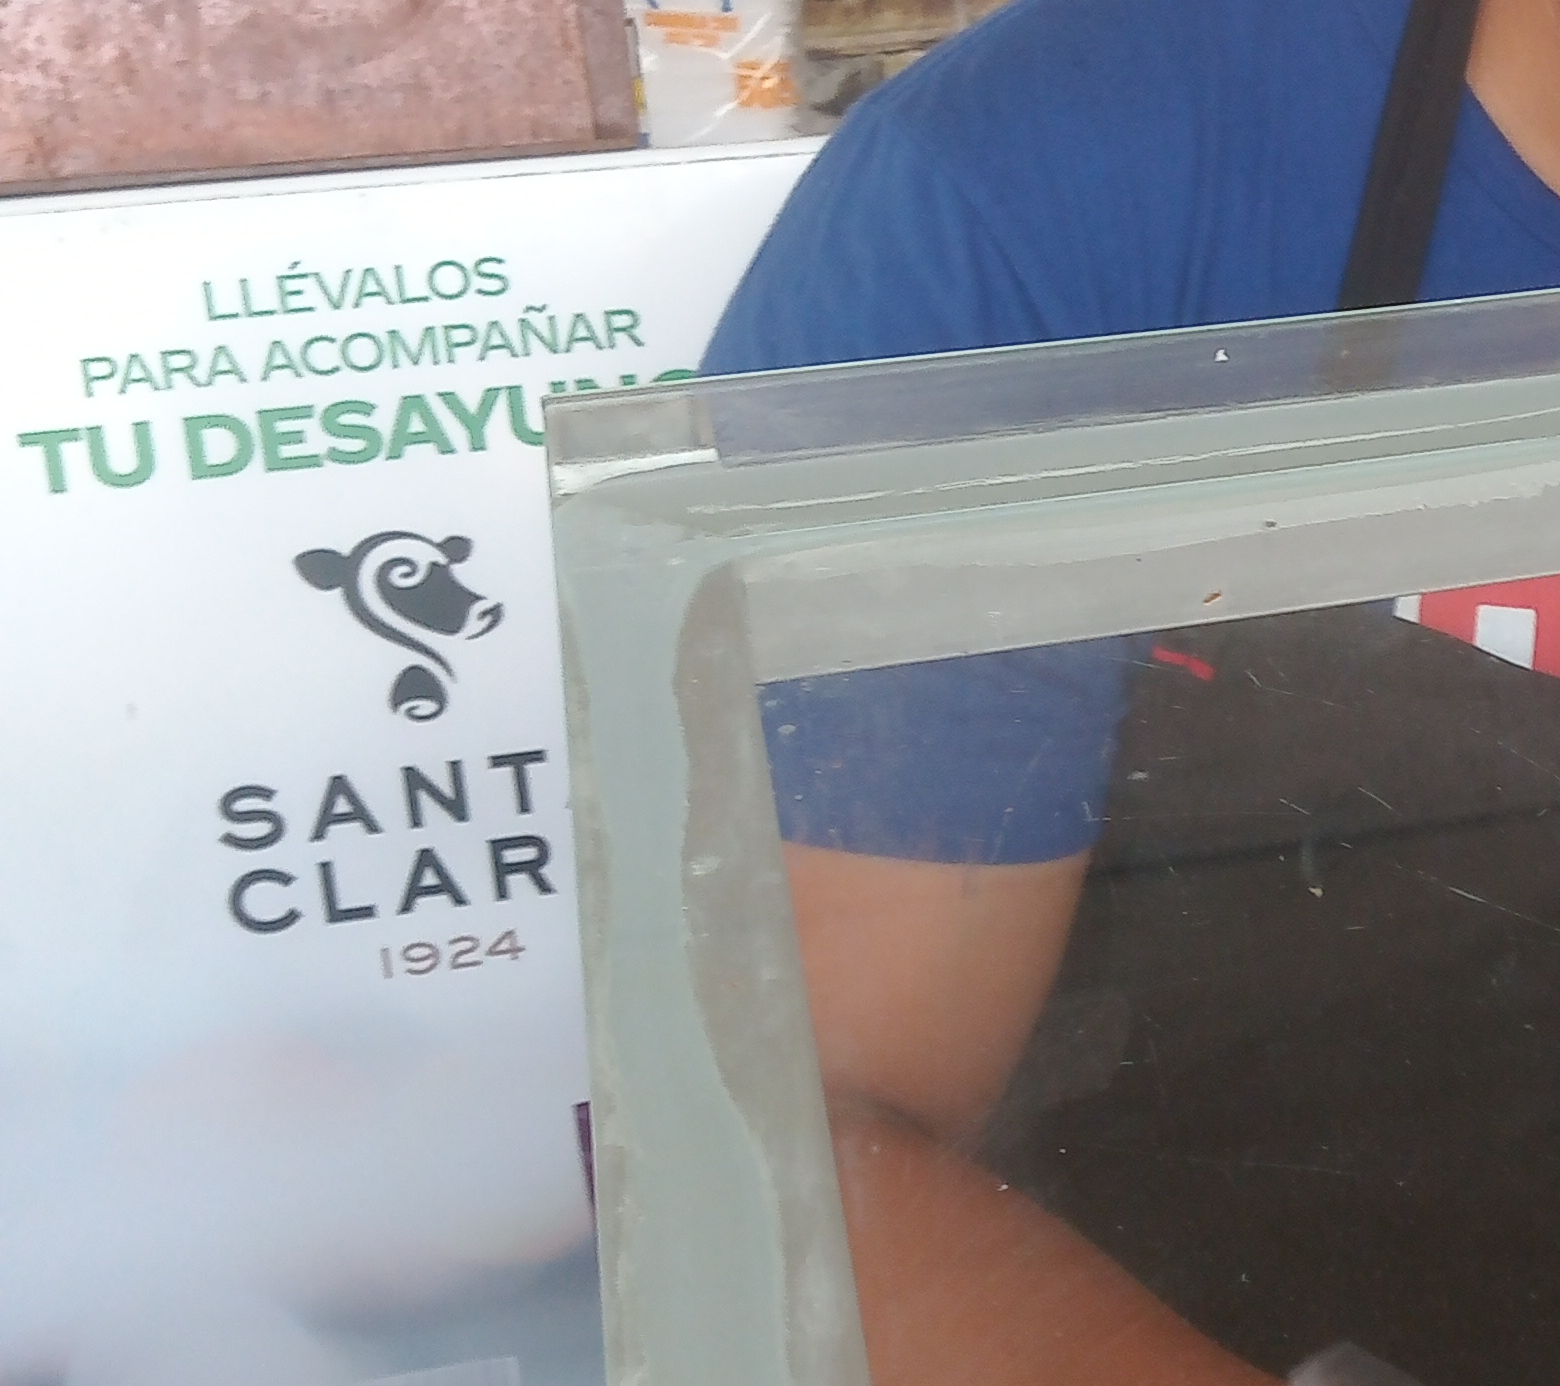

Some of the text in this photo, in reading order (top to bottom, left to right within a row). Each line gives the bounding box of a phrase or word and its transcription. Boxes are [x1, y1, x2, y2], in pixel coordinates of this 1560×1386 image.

[202, 255, 511, 321] LLÉVALOS
[79, 303, 645, 397] PARA ACOMPAÑAR
[17, 369, 698, 493] TU DESAYU
[218, 749, 548, 852] SANT
[228, 834, 557, 934] CLAR
[379, 928, 526, 979] 1924
